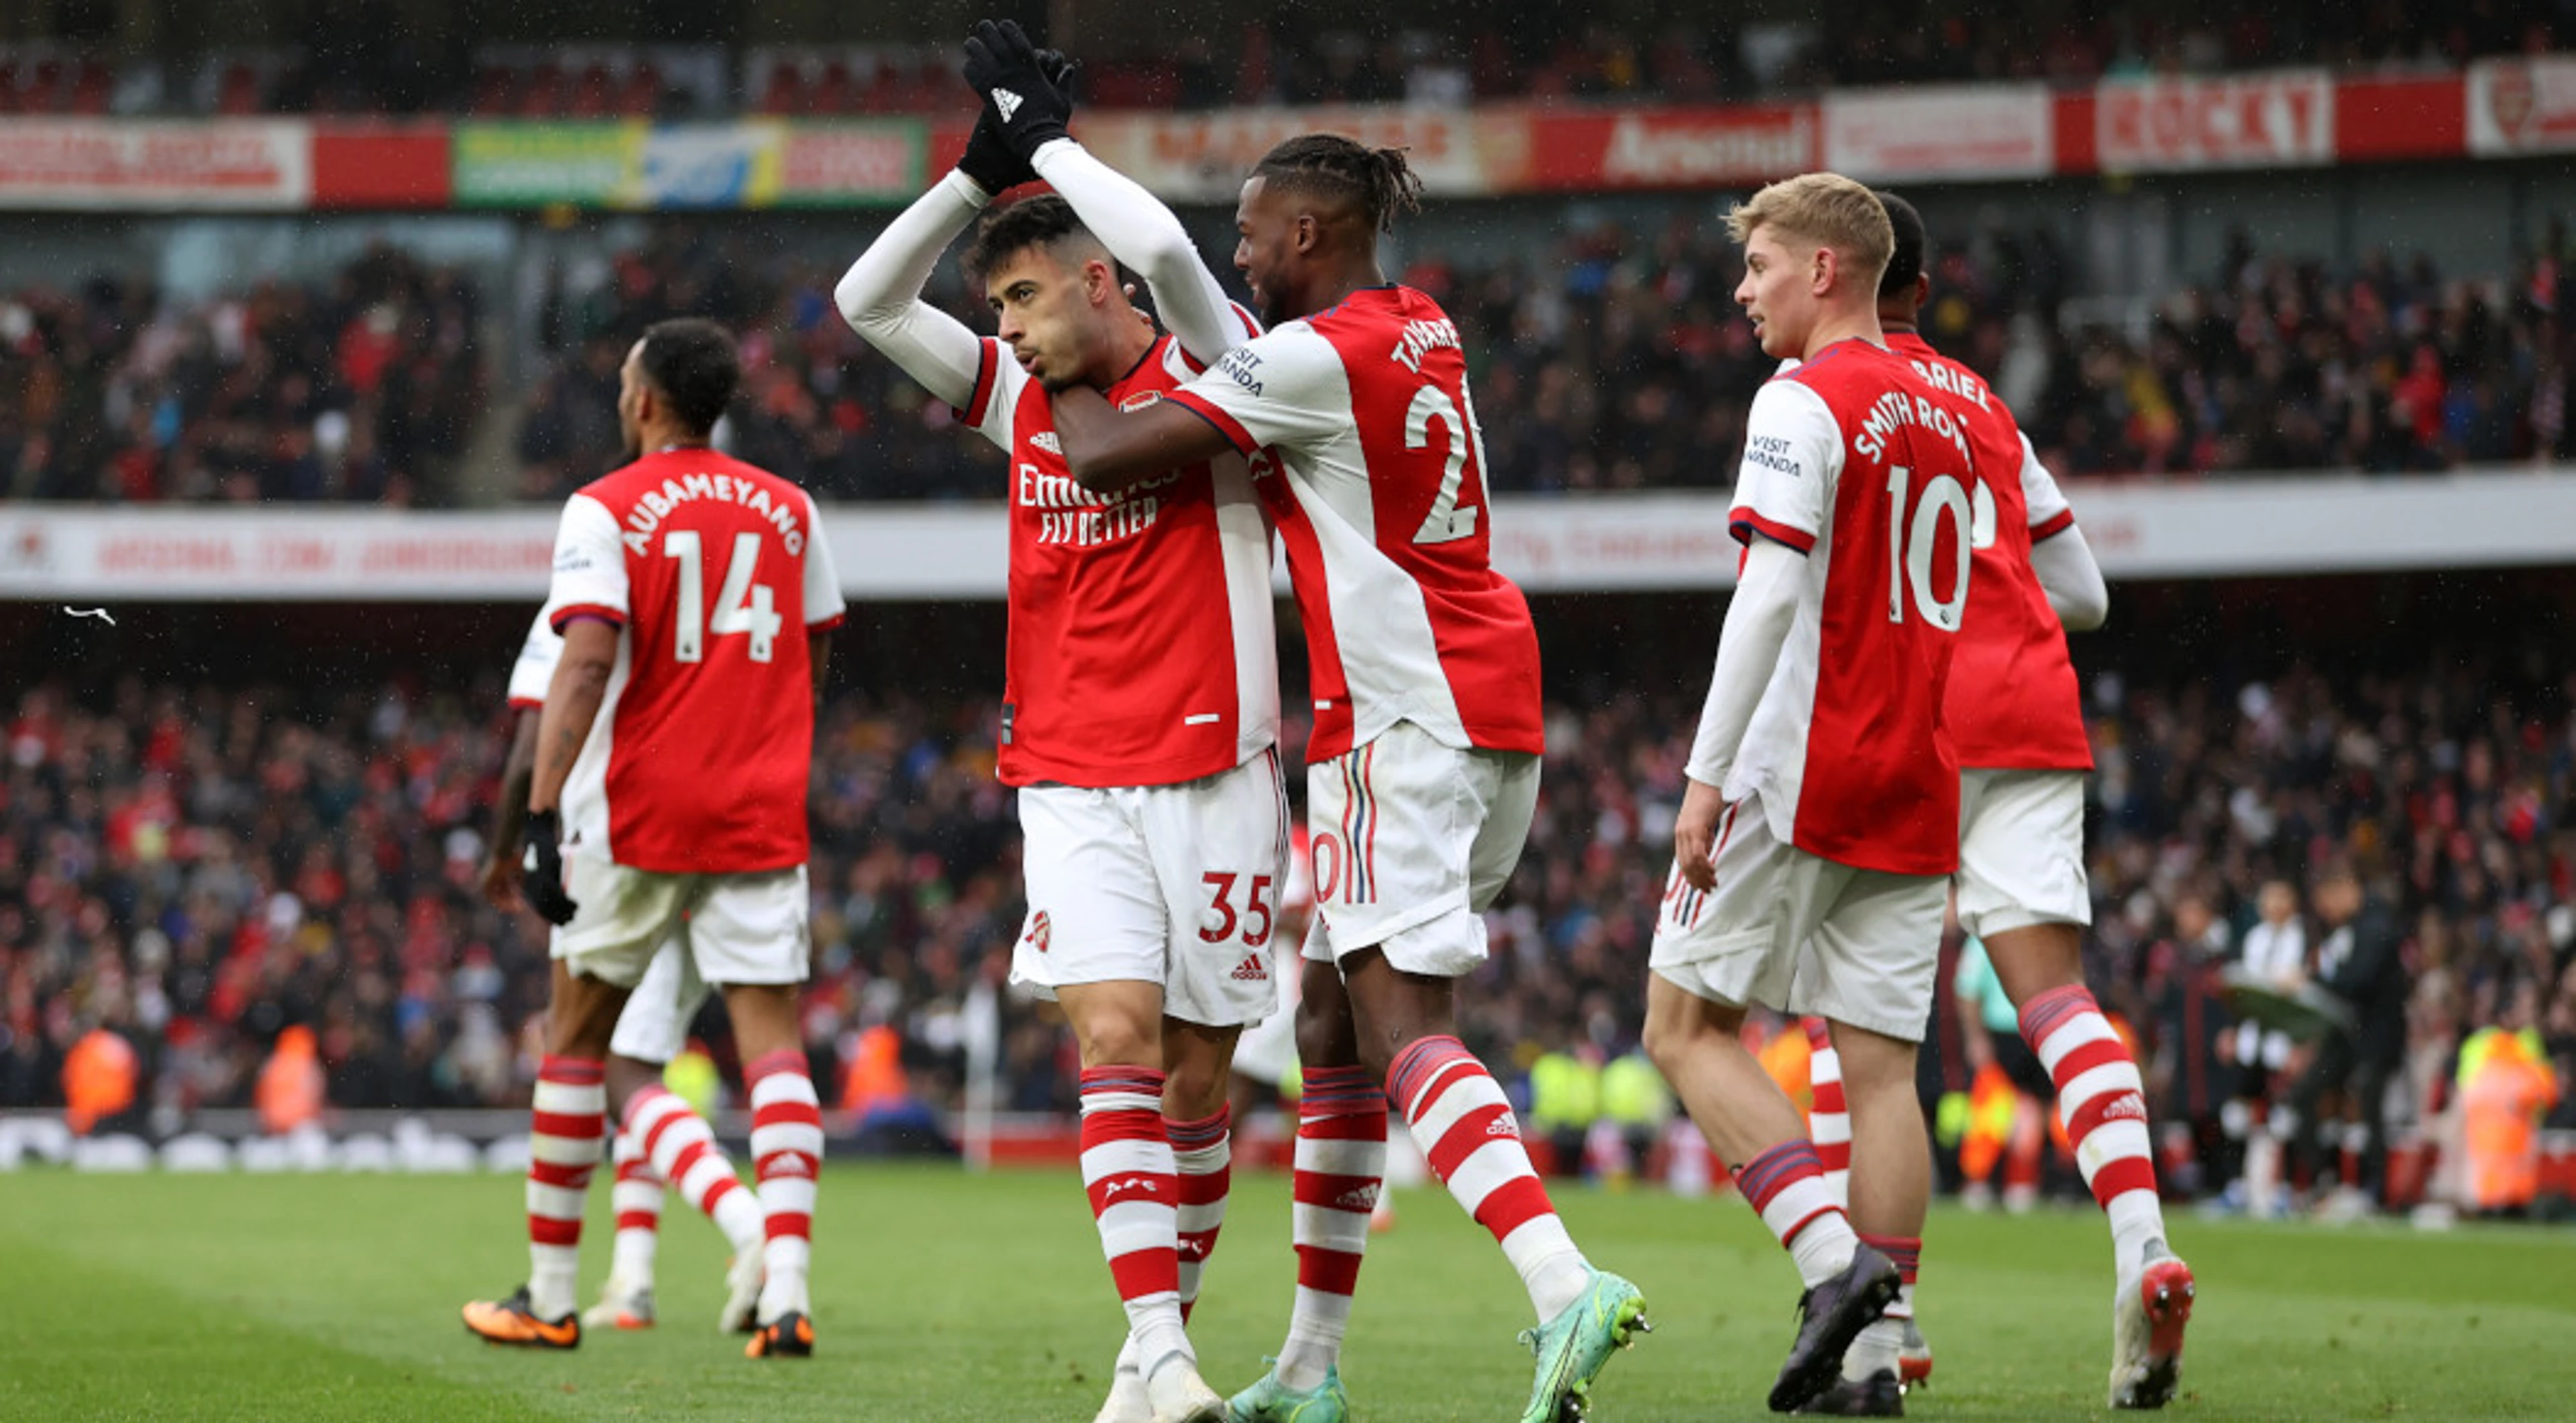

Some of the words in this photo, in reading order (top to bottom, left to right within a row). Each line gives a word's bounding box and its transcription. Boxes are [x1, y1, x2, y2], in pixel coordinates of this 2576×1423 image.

[1391, 318, 1462, 374] TAVARE
[1911, 360, 1991, 413] BRIEL
[1405, 371, 1489, 544] 2
[1747, 450, 1801, 477] WANDA
[1752, 435, 1792, 454] VISIT
[1854, 392, 1915, 464] SMITH
[1915, 395, 1973, 474] ROW
[623, 474, 804, 556] AUBAMEYANG
[1078, 496, 1157, 546] BETTER
[1887, 465, 1972, 632] 10
[664, 530, 782, 663] 14
[1312, 833, 1340, 903] 0
[1199, 872, 1271, 947] 35
